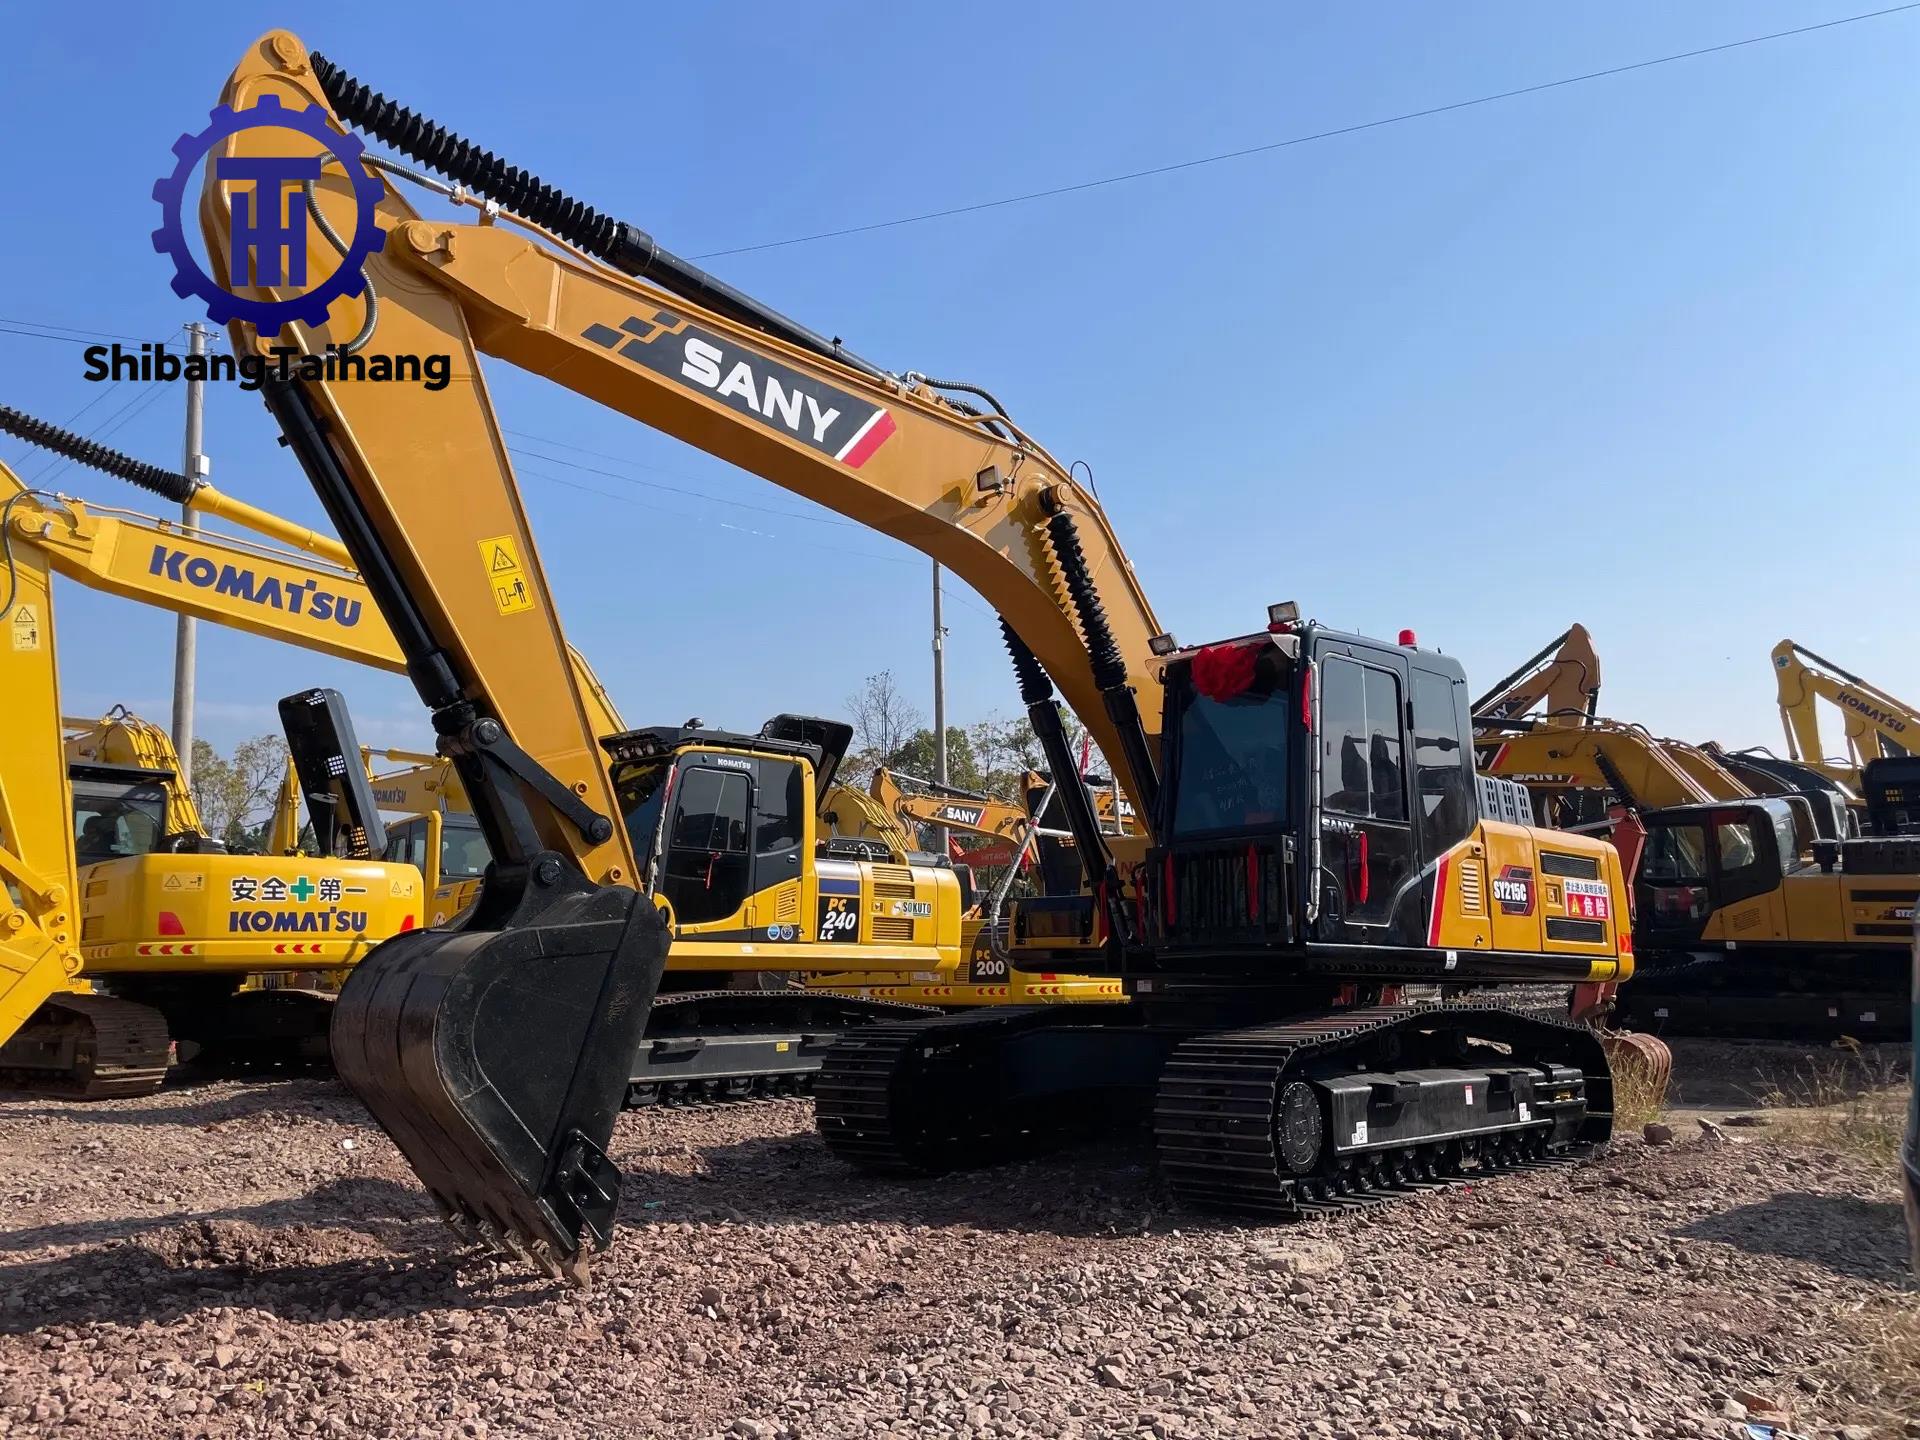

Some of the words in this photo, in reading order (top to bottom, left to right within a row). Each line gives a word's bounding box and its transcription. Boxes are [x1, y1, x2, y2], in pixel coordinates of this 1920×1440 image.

[681, 337, 841, 443] SANY
[148, 544, 362, 628] KOMATSU
[1836, 691, 1906, 732] KOMATSU
[717, 757, 751, 769] KOMATSU
[946, 807, 977, 823] SANY
[1321, 817, 1355, 834] SANY
[231, 877, 287, 902] 安全
[318, 877, 367, 902] 第一
[1493, 880, 1527, 902] SY215C
[827, 897, 848, 912] PC
[902, 901, 932, 915] SOKUTO
[1583, 895, 1607, 917] 危险
[229, 906, 368, 932] KOMATSU
[822, 911, 856, 931] 240
[819, 929, 834, 940] LC
[975, 949, 991, 960] PC
[976, 960, 1005, 976] 200
